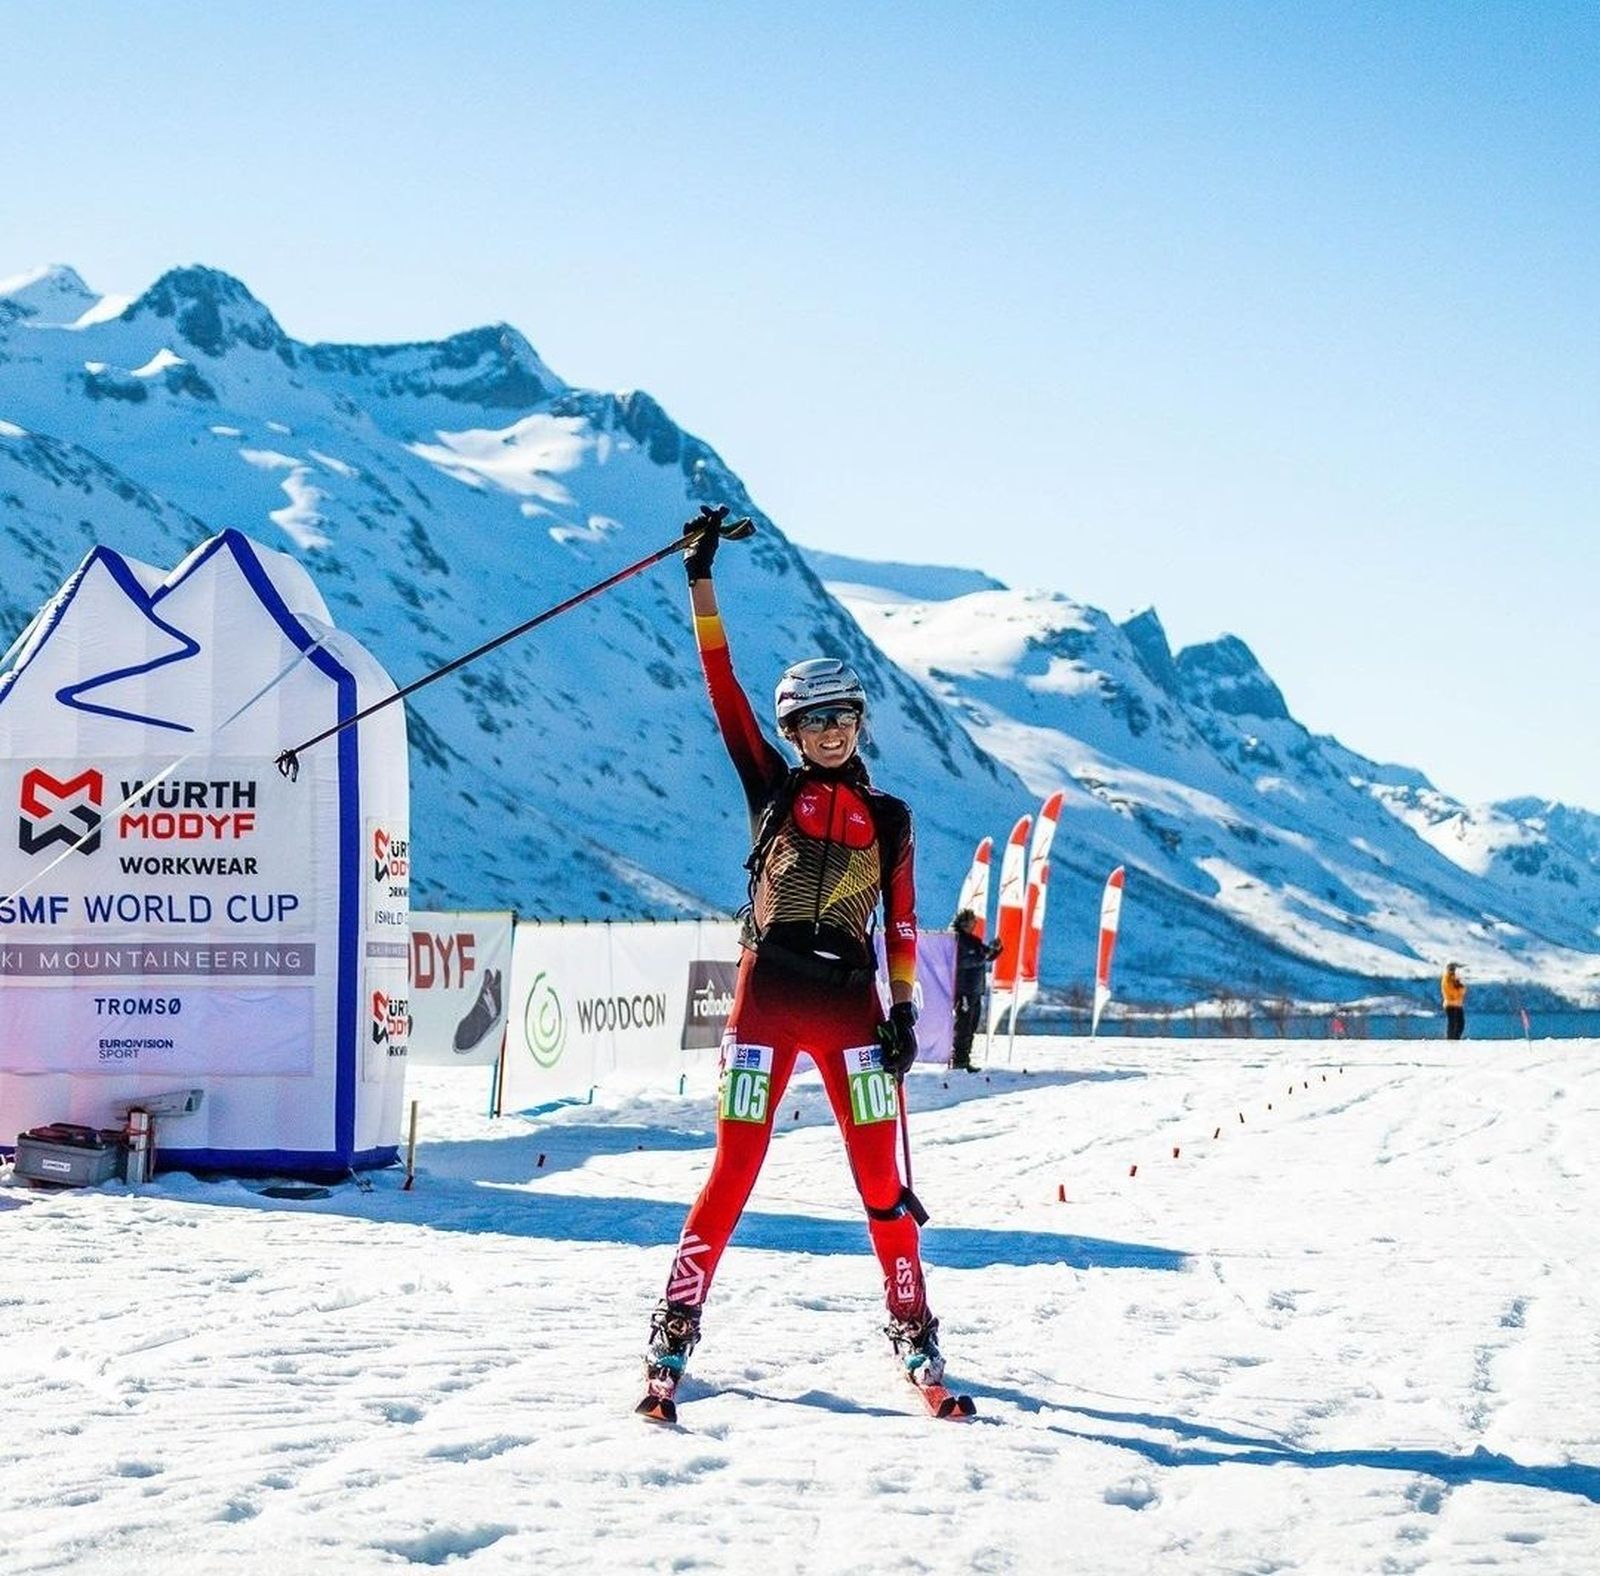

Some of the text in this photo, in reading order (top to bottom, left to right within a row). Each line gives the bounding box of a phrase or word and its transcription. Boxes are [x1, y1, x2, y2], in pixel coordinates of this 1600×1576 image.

[120, 780, 256, 808] WÜRTH
[120, 813, 255, 839] MODYF
[120, 857, 258, 875] WORKWEAR
[84, 894, 212, 923] WORLD
[226, 894, 299, 922] CUP
[40, 951, 301, 969] MOUNTAINEERING
[408, 931, 475, 989] DYF
[94, 998, 181, 1015] TROMSØ
[577, 993, 666, 1034] WOODCON
[99, 1049, 140, 1059] SPORT
[896, 1256, 915, 1300] ESP
